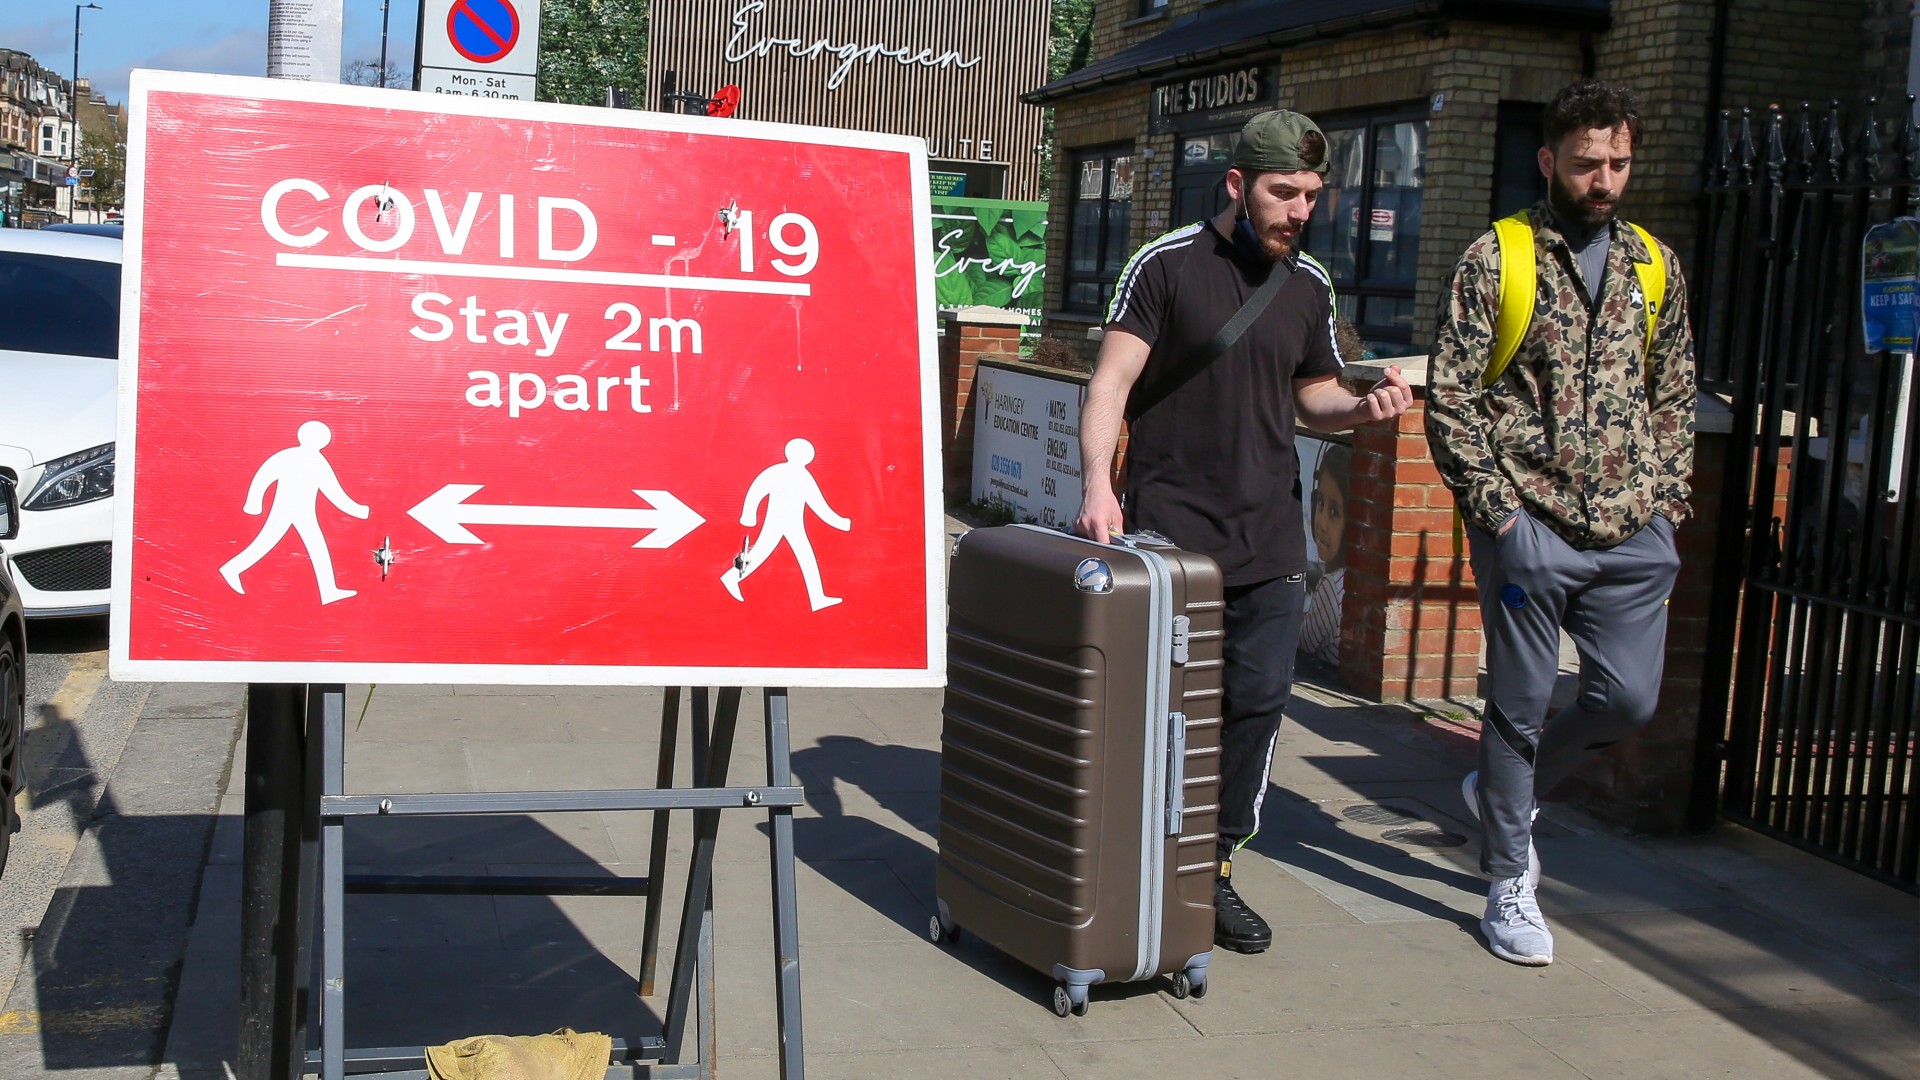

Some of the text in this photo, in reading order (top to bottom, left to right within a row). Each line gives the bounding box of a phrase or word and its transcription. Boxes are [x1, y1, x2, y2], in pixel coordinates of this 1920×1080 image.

[725, 1, 982, 91] Evergreen
[452, 74, 476, 86] Mon
[486, 77, 506, 88] Sat
[1156, 67, 1258, 116] THE STUDIOS
[927, 136, 993, 160] UITE
[260, 177, 599, 262] COVID
[733, 209, 821, 277] 19
[934, 228, 1046, 298] Everg
[1870, 293, 1916, 307] KEEP A SAF
[408, 291, 703, 357] Stay 2m
[464, 364, 652, 418] apart
[994, 392, 1025, 416] HARINGEY
[1049, 400, 1066, 420] MATHS
[994, 414, 1039, 440] EDUCATION CENTRE
[1047, 438, 1068, 460] ENGLISH
[1044, 477, 1057, 498] ESOL
[1043, 506, 1056, 526] GCSE
